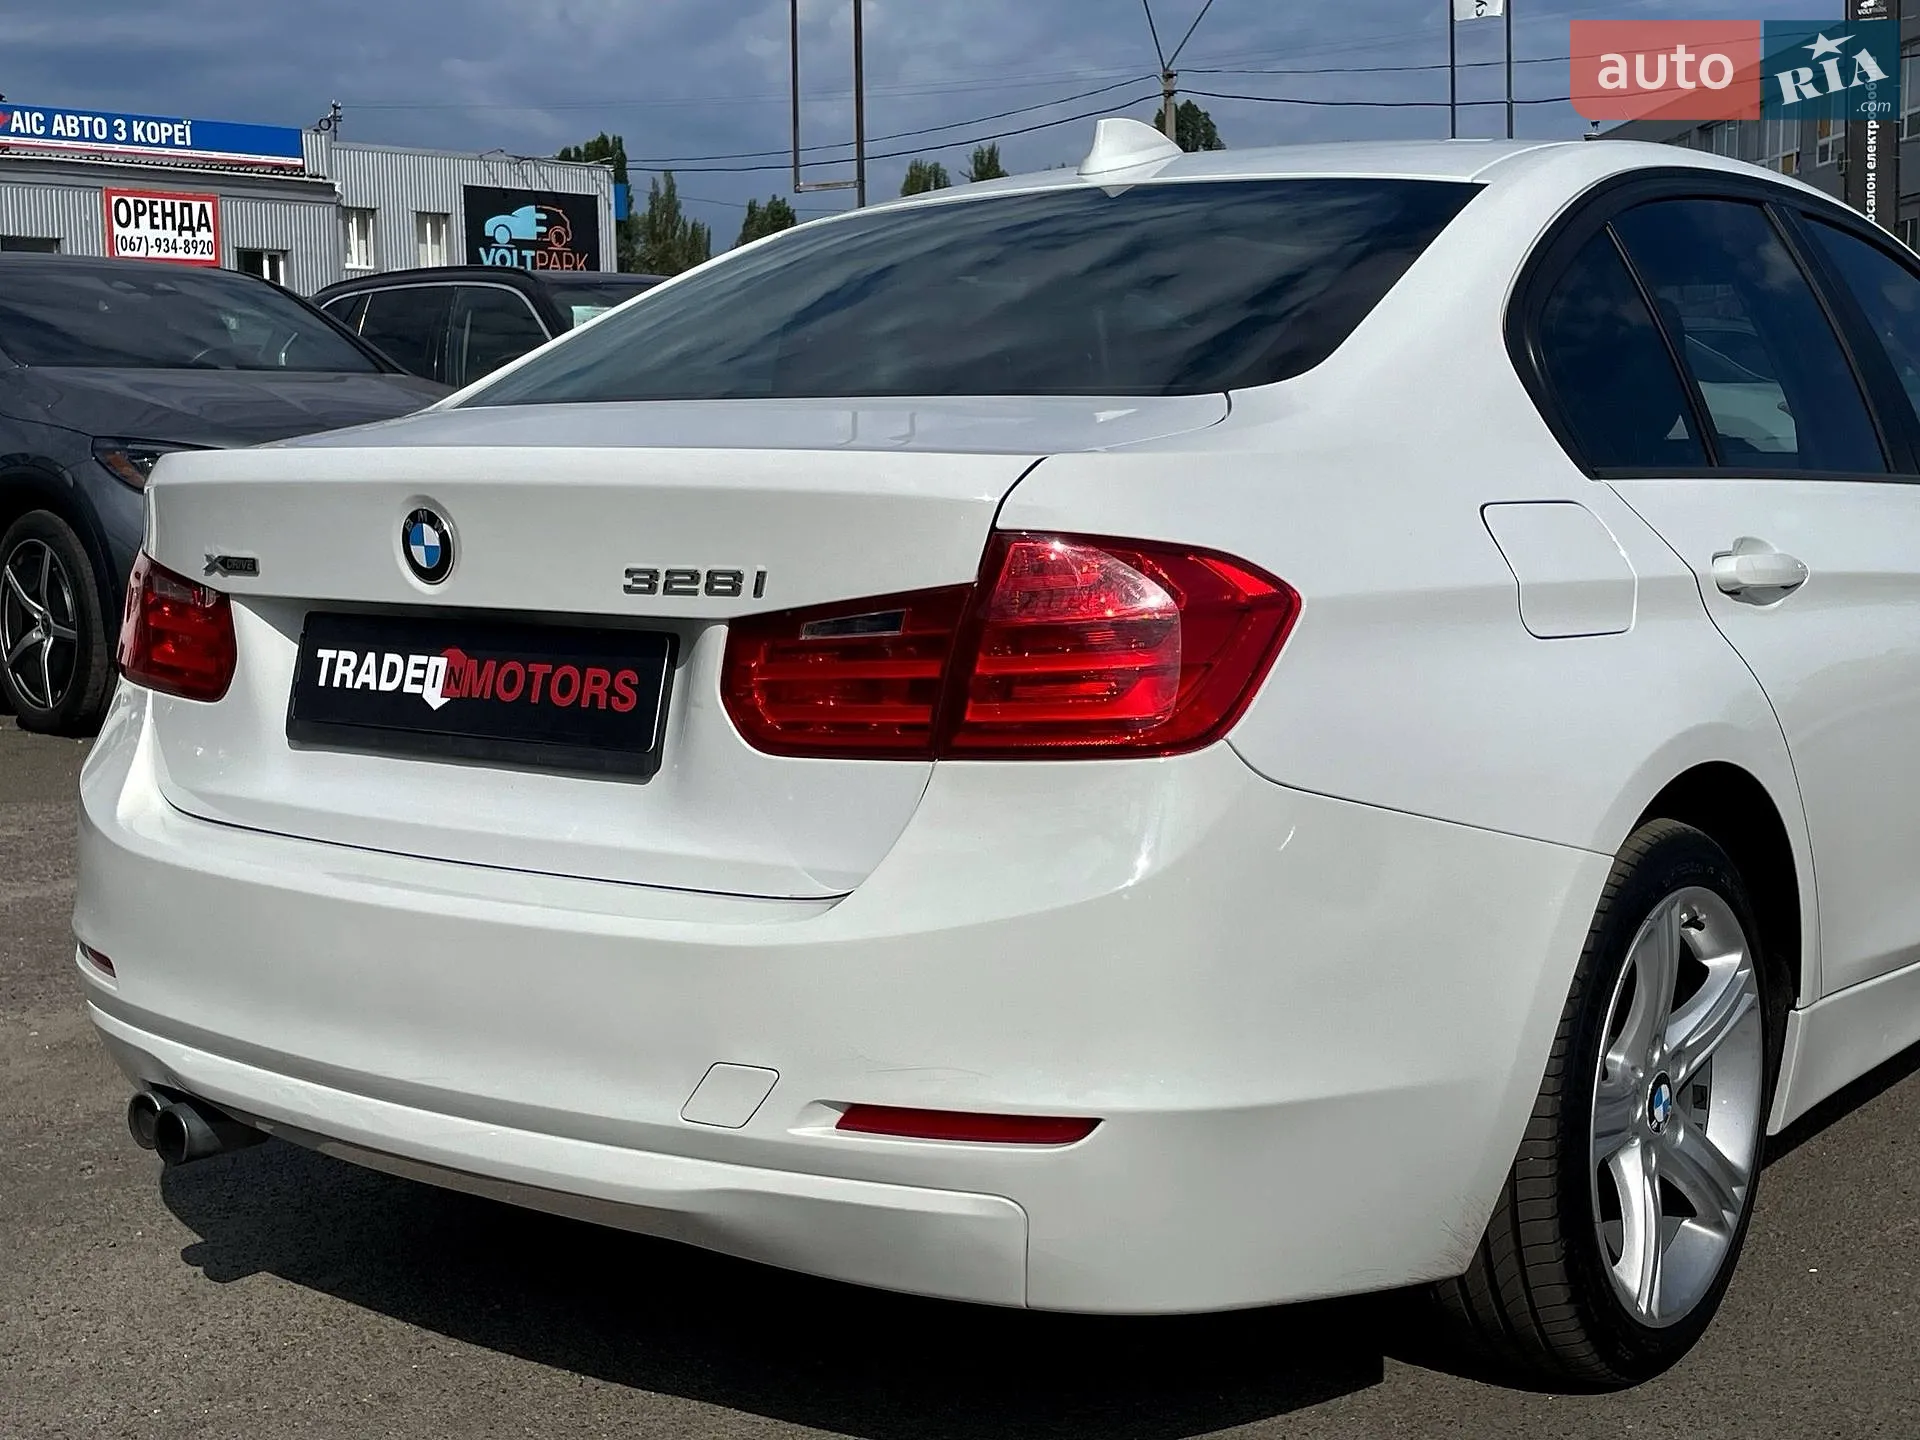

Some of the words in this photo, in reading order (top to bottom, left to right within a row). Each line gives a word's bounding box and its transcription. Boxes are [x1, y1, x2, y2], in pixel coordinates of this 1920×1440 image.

[10, 110, 46, 135] АІС
[51, 114, 108, 140] АВТО
[132, 120, 192, 146] КОРЕЇ
[114, 197, 212, 238] ОРЕНДА
[115, 234, 214, 256] (067)-934-8920
